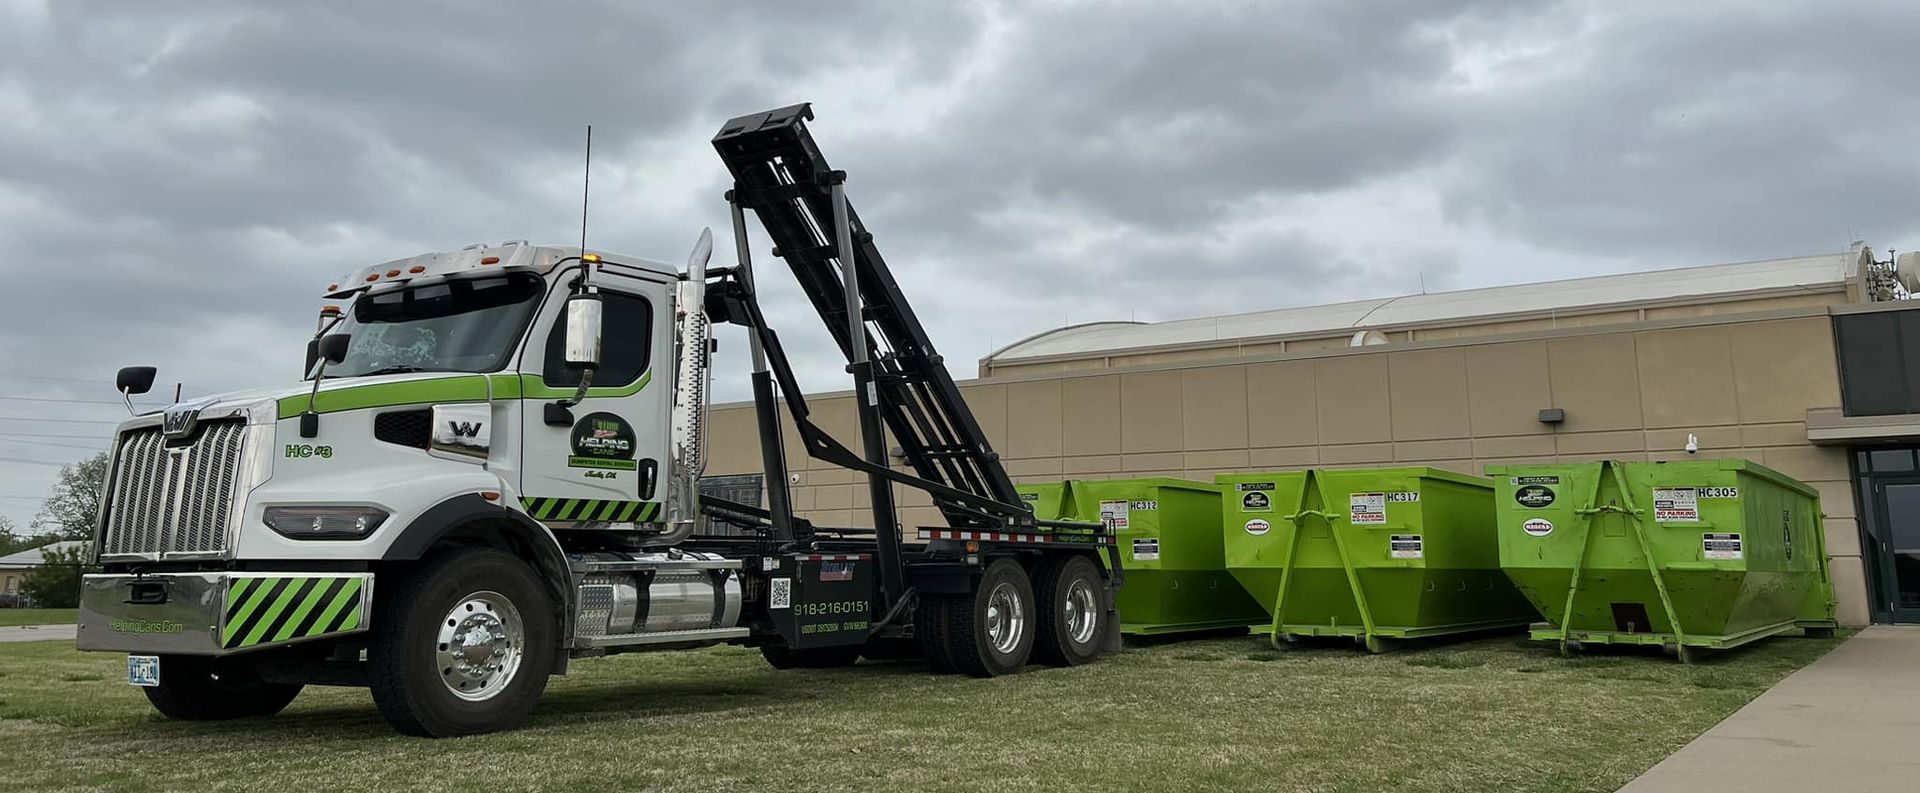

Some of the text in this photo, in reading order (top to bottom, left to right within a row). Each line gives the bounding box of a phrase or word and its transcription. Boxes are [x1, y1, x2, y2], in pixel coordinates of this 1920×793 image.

[579, 437, 630, 449] HELPING
[286, 444, 313, 458] HC
[1387, 492, 1419, 501] HC317
[1698, 488, 1737, 498] HC305
[1130, 501, 1157, 510] HC312
[794, 600, 869, 616] 918-216-0151
